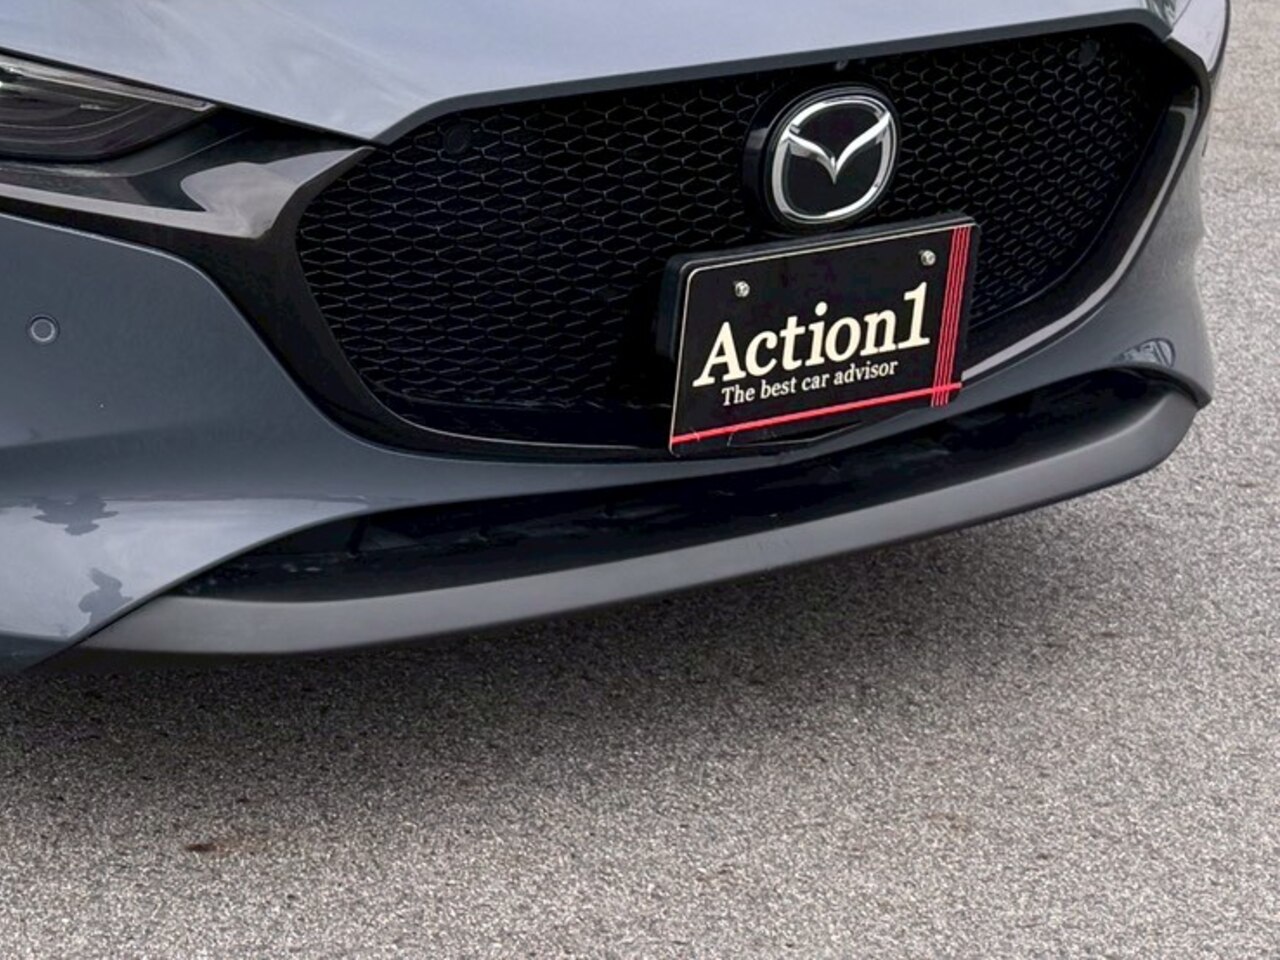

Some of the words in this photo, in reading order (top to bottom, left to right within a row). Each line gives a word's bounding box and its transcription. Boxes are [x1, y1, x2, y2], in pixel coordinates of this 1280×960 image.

[692, 281, 931, 388] Action1
[721, 384, 756, 406] The
[760, 379, 797, 399] best
[801, 373, 830, 391] car
[833, 360, 898, 386] advisor
